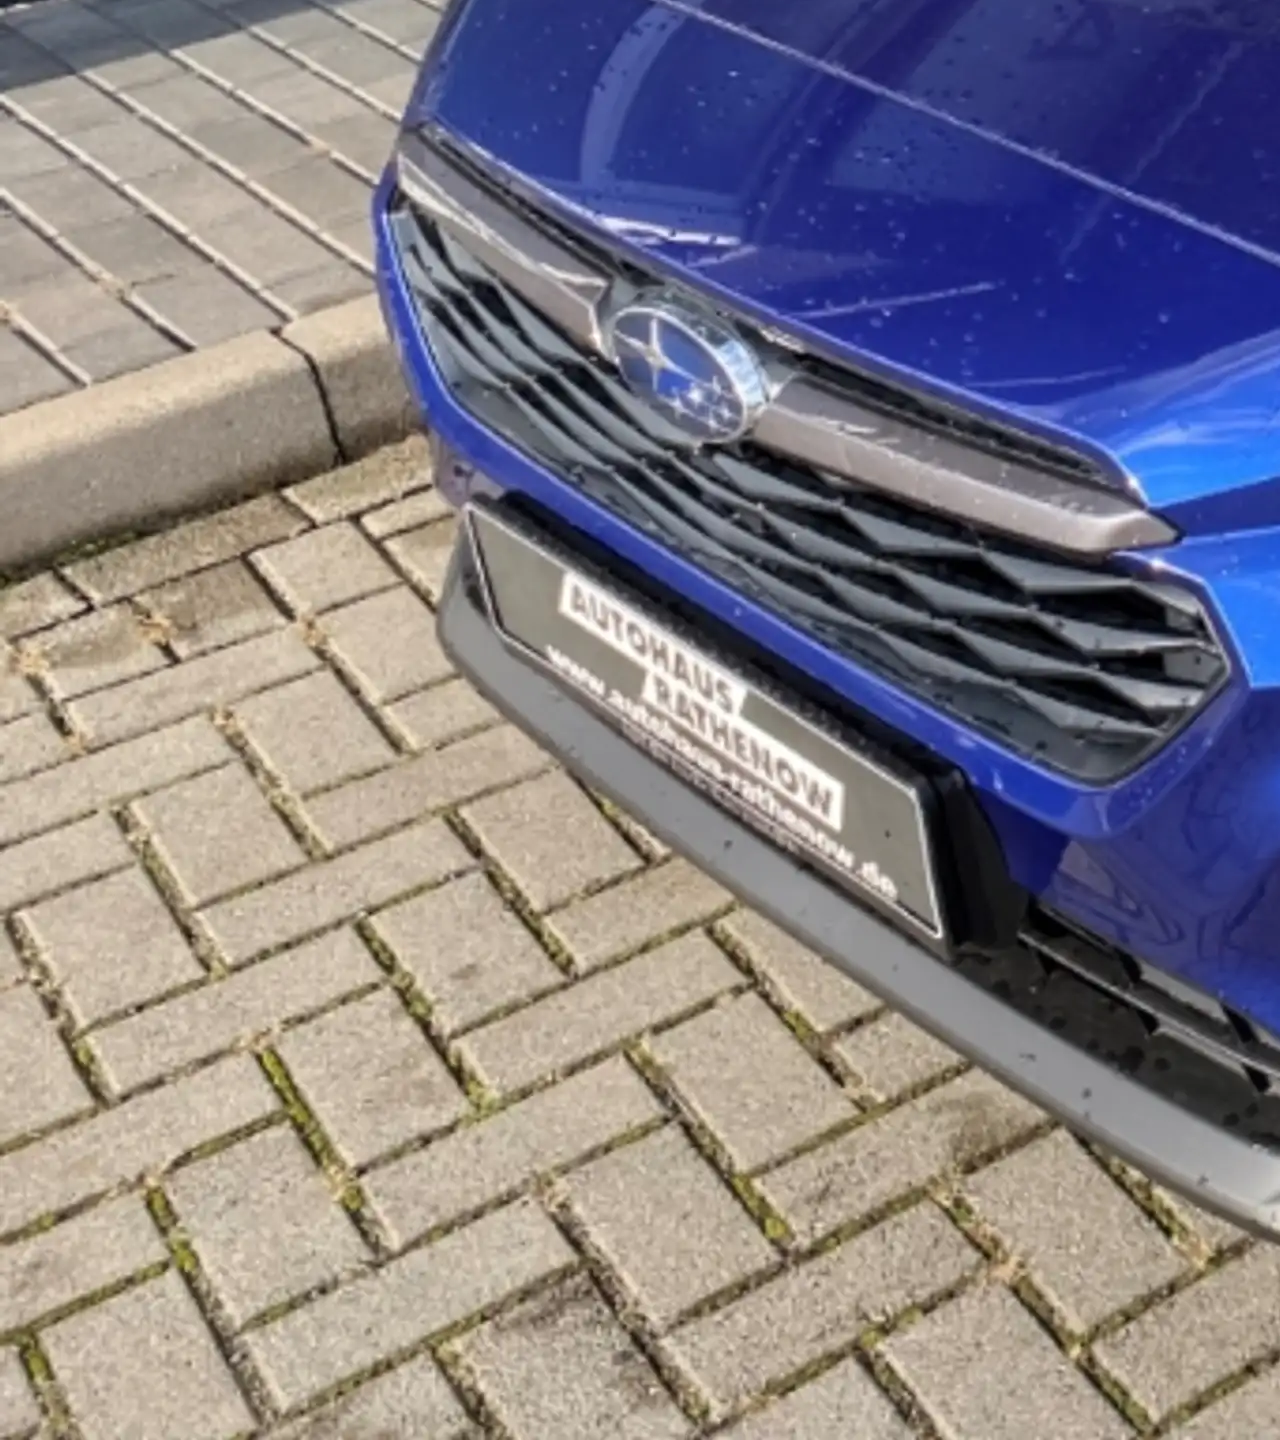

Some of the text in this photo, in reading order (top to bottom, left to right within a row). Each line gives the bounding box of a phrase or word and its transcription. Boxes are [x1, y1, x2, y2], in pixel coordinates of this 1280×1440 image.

[569, 583, 736, 714] AUTOHAUS
[546, 645, 898, 900] www.autohaus-rathenow.de
[655, 679, 834, 816] RATHENOW
